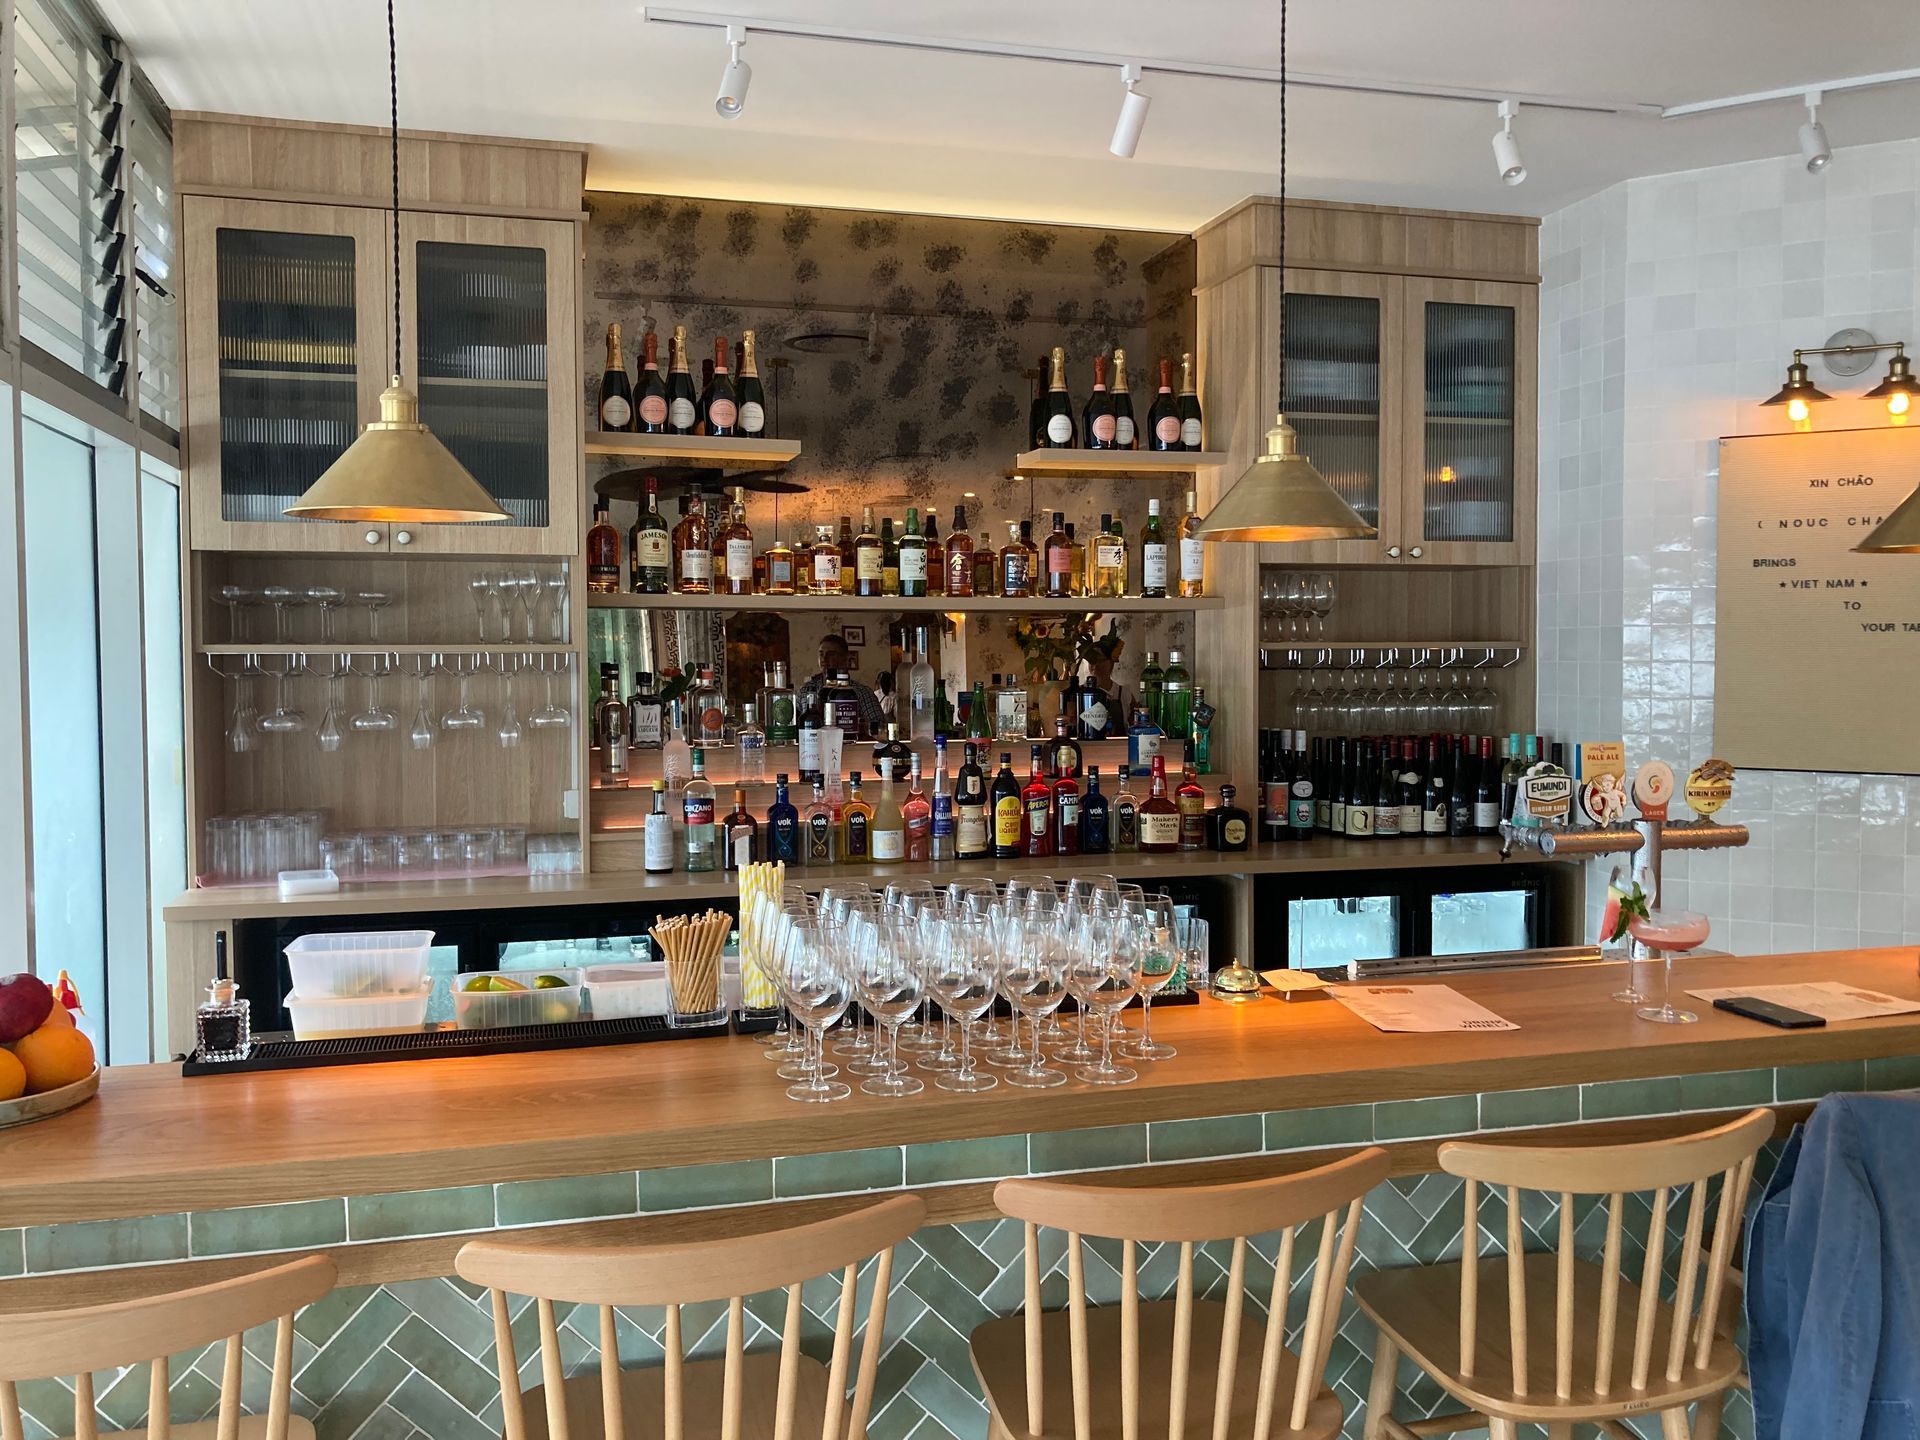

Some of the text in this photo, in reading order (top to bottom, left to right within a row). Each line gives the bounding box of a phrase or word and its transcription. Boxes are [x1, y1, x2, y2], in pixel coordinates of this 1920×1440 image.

[1809, 479, 1829, 488] XIN
[1779, 518, 1829, 529] NOUC
[640, 531, 668, 541] JAMESON
[1752, 558, 1797, 568] BRINGS
[1791, 579, 1855, 589] VIET NAM
[1843, 601, 1862, 611] TO
[1861, 623, 1896, 633] YOUR
[1531, 781, 1567, 792] EUMUNDI
[684, 804, 712, 813] CINZANO
[1089, 806, 1103, 815] vok
[1120, 806, 1133, 814] vok
[777, 817, 792, 826] vok
[812, 817, 827, 826] vok
[851, 815, 865, 824] vok
